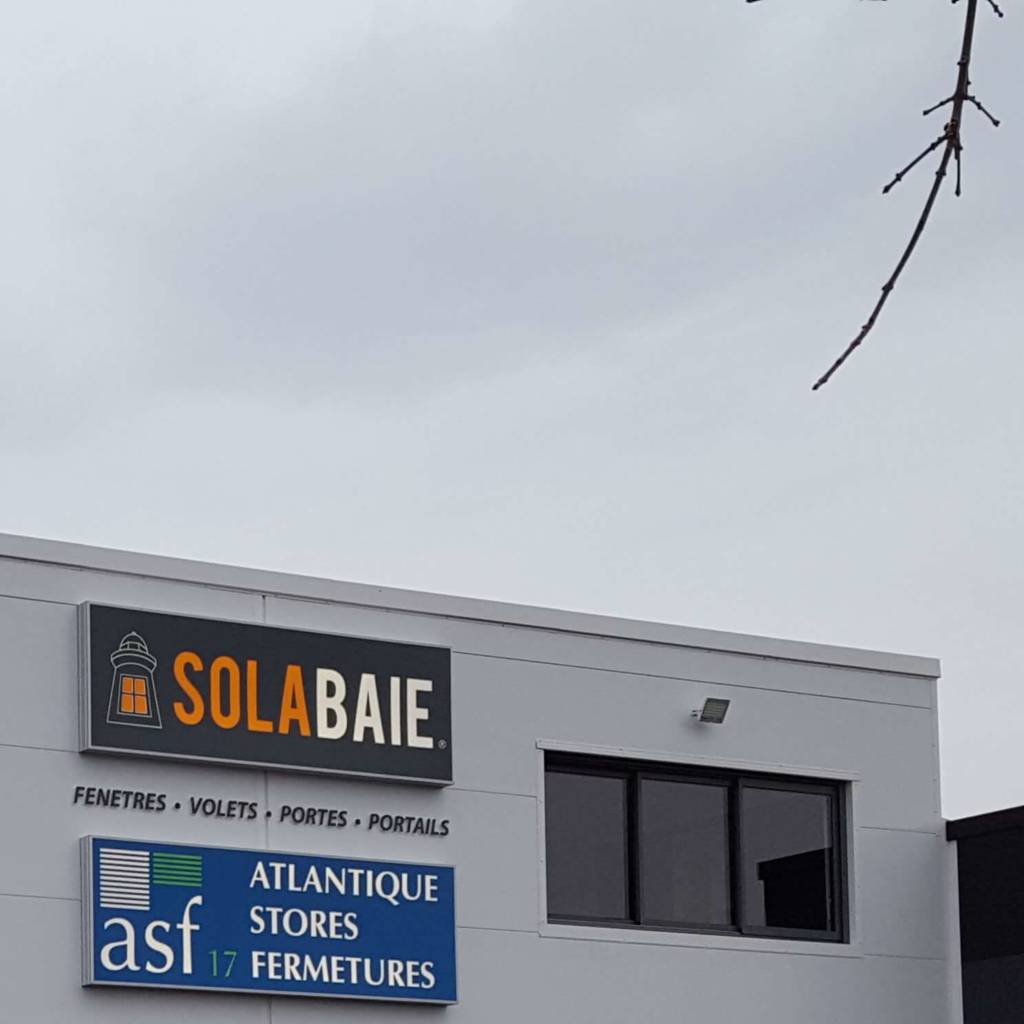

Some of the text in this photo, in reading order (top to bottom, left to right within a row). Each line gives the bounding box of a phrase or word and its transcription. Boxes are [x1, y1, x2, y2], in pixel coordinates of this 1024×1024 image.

[172, 651, 434, 749] SOLABAIE
[74, 786, 450, 836] FENETRES VOLETS PORTES PORTAILS
[249, 861, 438, 906] ATLANTIQUE
[99, 895, 237, 977] asf 17
[250, 906, 359, 940] STORES
[251, 950, 436, 989] FERMETURES
